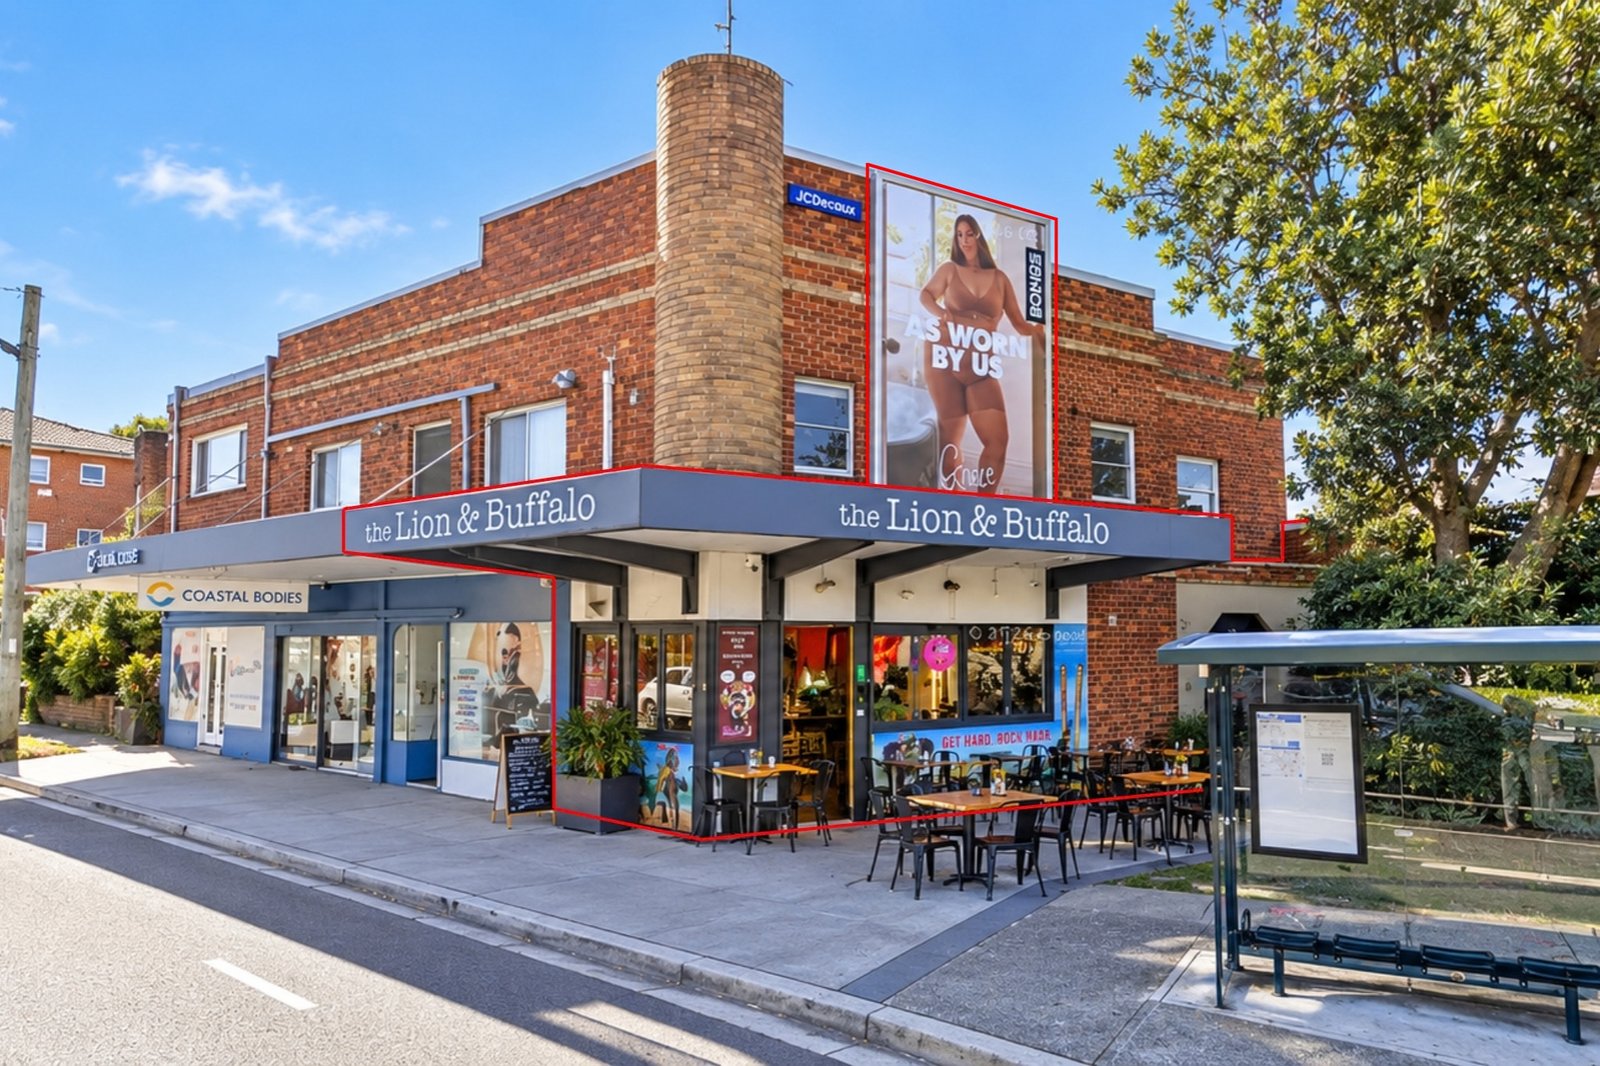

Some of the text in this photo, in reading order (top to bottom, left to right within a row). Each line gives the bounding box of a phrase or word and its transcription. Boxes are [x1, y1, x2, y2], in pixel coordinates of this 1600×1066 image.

[796, 190, 856, 217] JCDecaux
[904, 314, 1027, 359] AS WORN
[932, 344, 1003, 379] BY US
[365, 487, 596, 543] the Lion & Buffalo
[839, 498, 1110, 545] the Lion & Buffalo
[182, 589, 303, 604] COASTAL BODIES
[942, 735, 961, 749] GET
